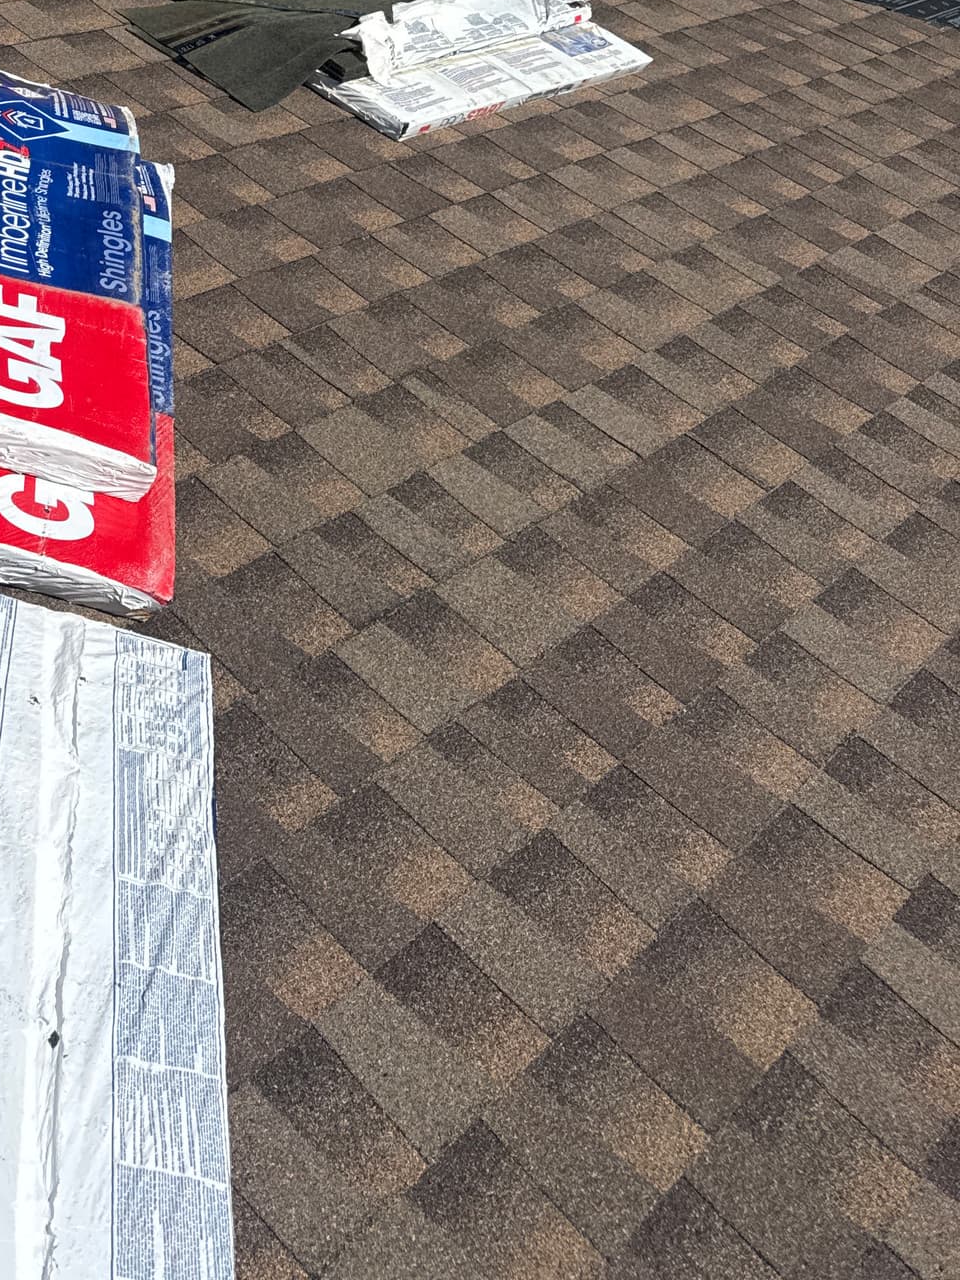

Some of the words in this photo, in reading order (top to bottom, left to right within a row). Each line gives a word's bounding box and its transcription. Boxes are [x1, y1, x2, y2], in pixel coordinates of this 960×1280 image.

[38, 168, 54, 195] Shingles
[97, 210, 132, 293] Shingles
[36, 257, 54, 278] High
